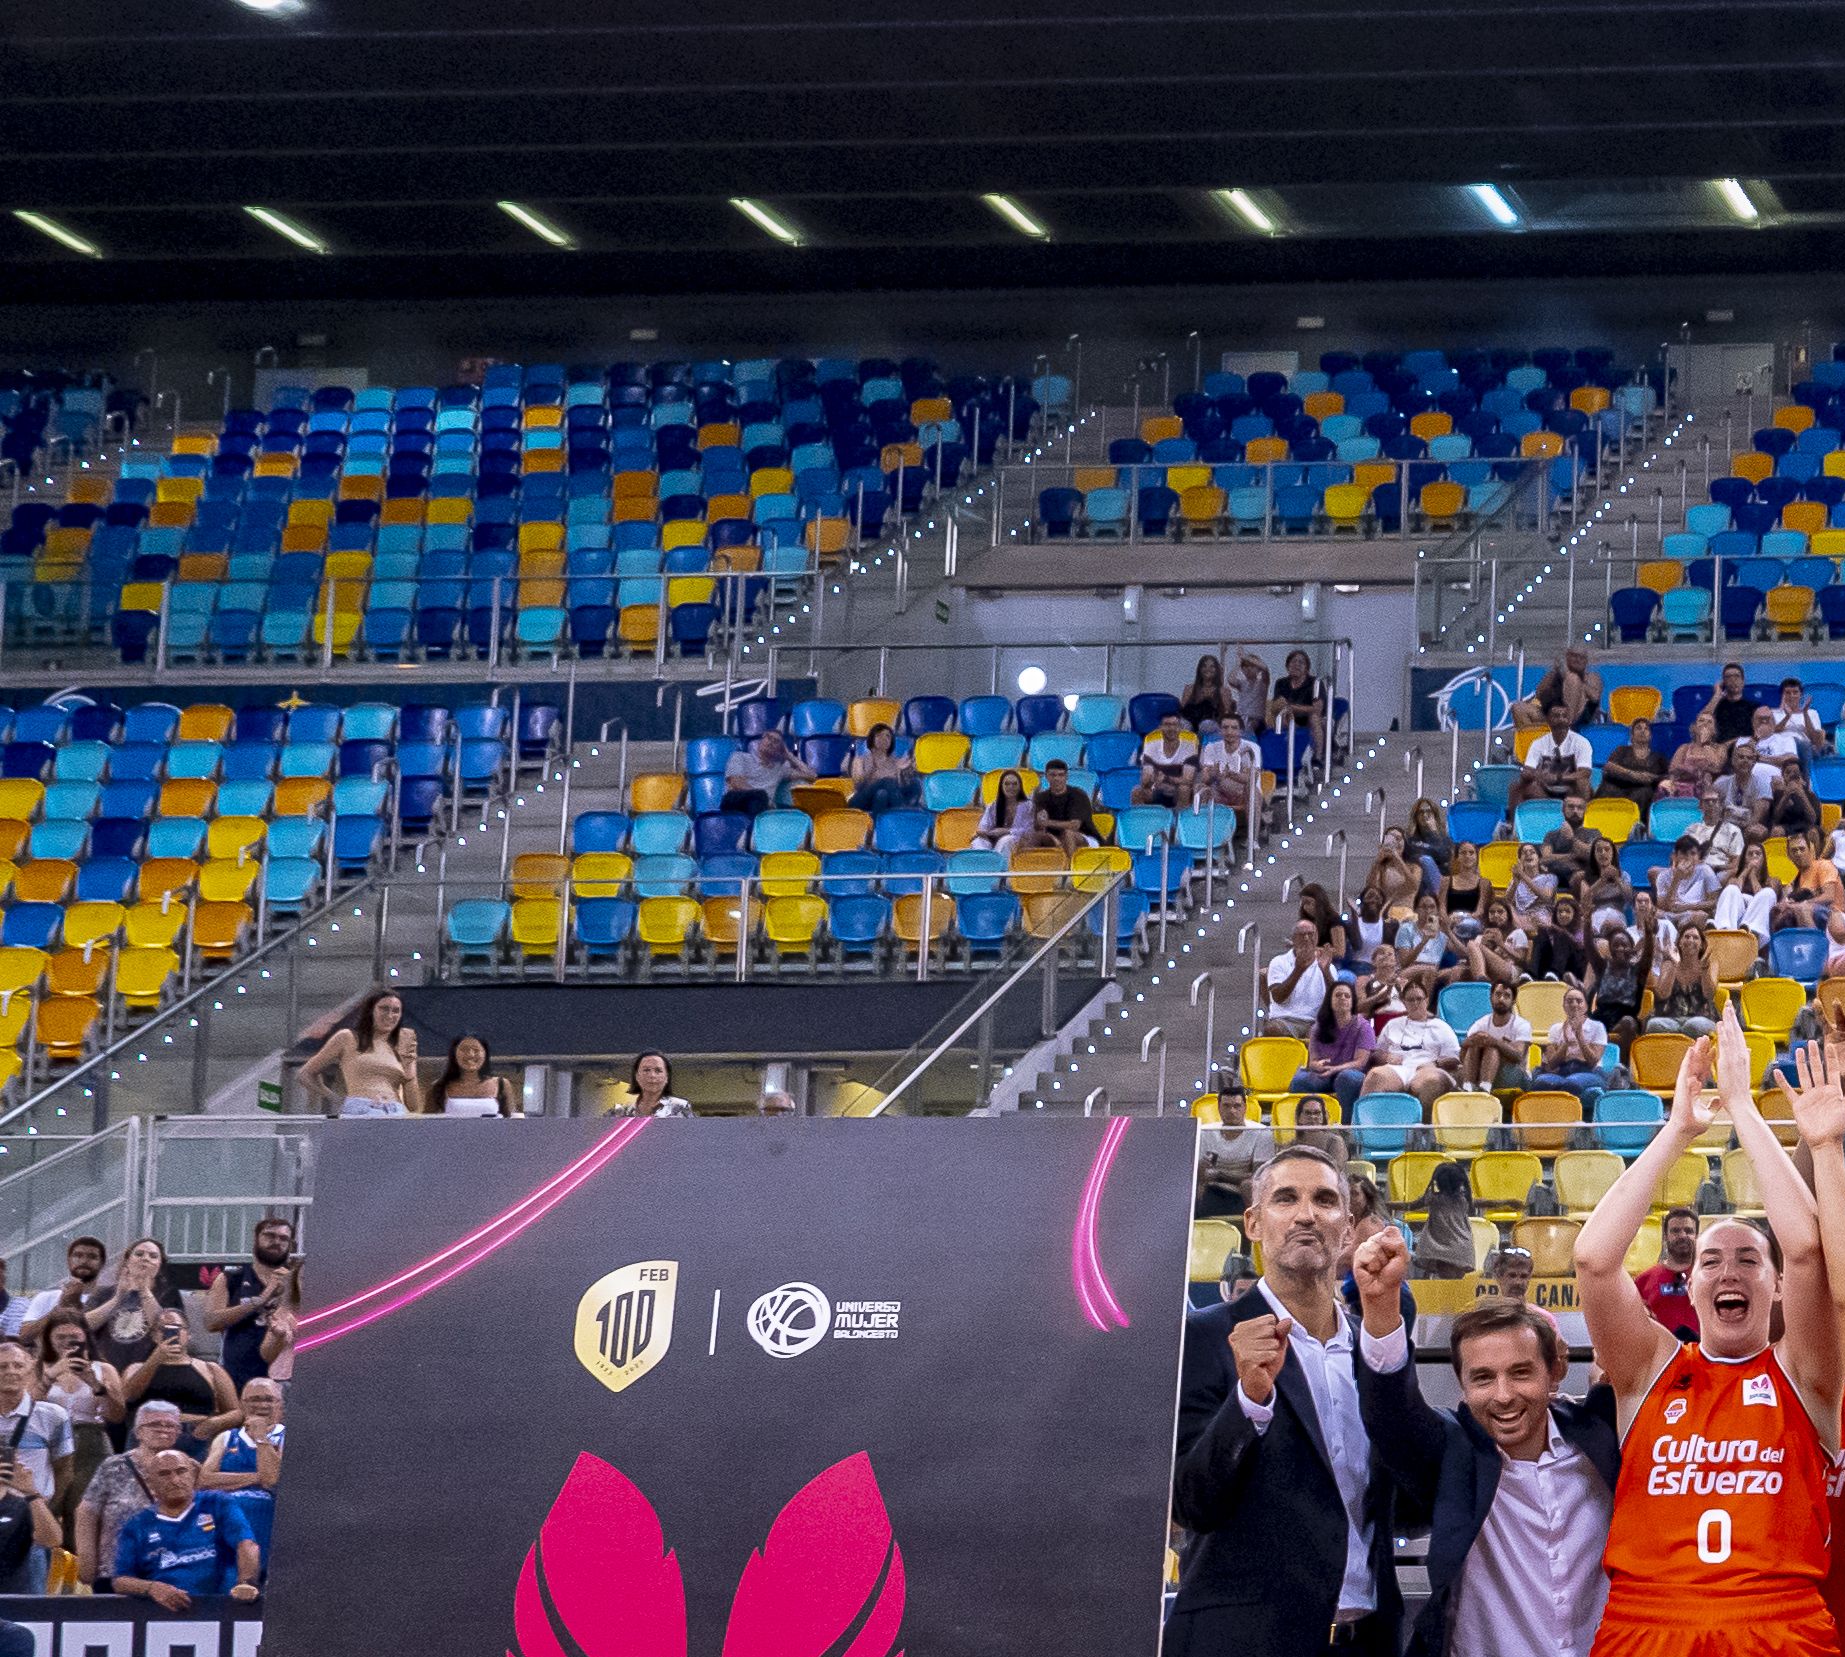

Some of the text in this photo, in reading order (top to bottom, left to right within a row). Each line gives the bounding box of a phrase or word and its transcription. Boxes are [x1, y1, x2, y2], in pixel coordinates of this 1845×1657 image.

[639, 1268, 669, 1281] FEB
[836, 1301, 901, 1313] UNIVERSO
[834, 1313, 899, 1328] MUJER
[1651, 1435, 1785, 1464] Cultura del
[1647, 1467, 1783, 1496] Esfuerzo
[1697, 1509, 1733, 1564] 0
